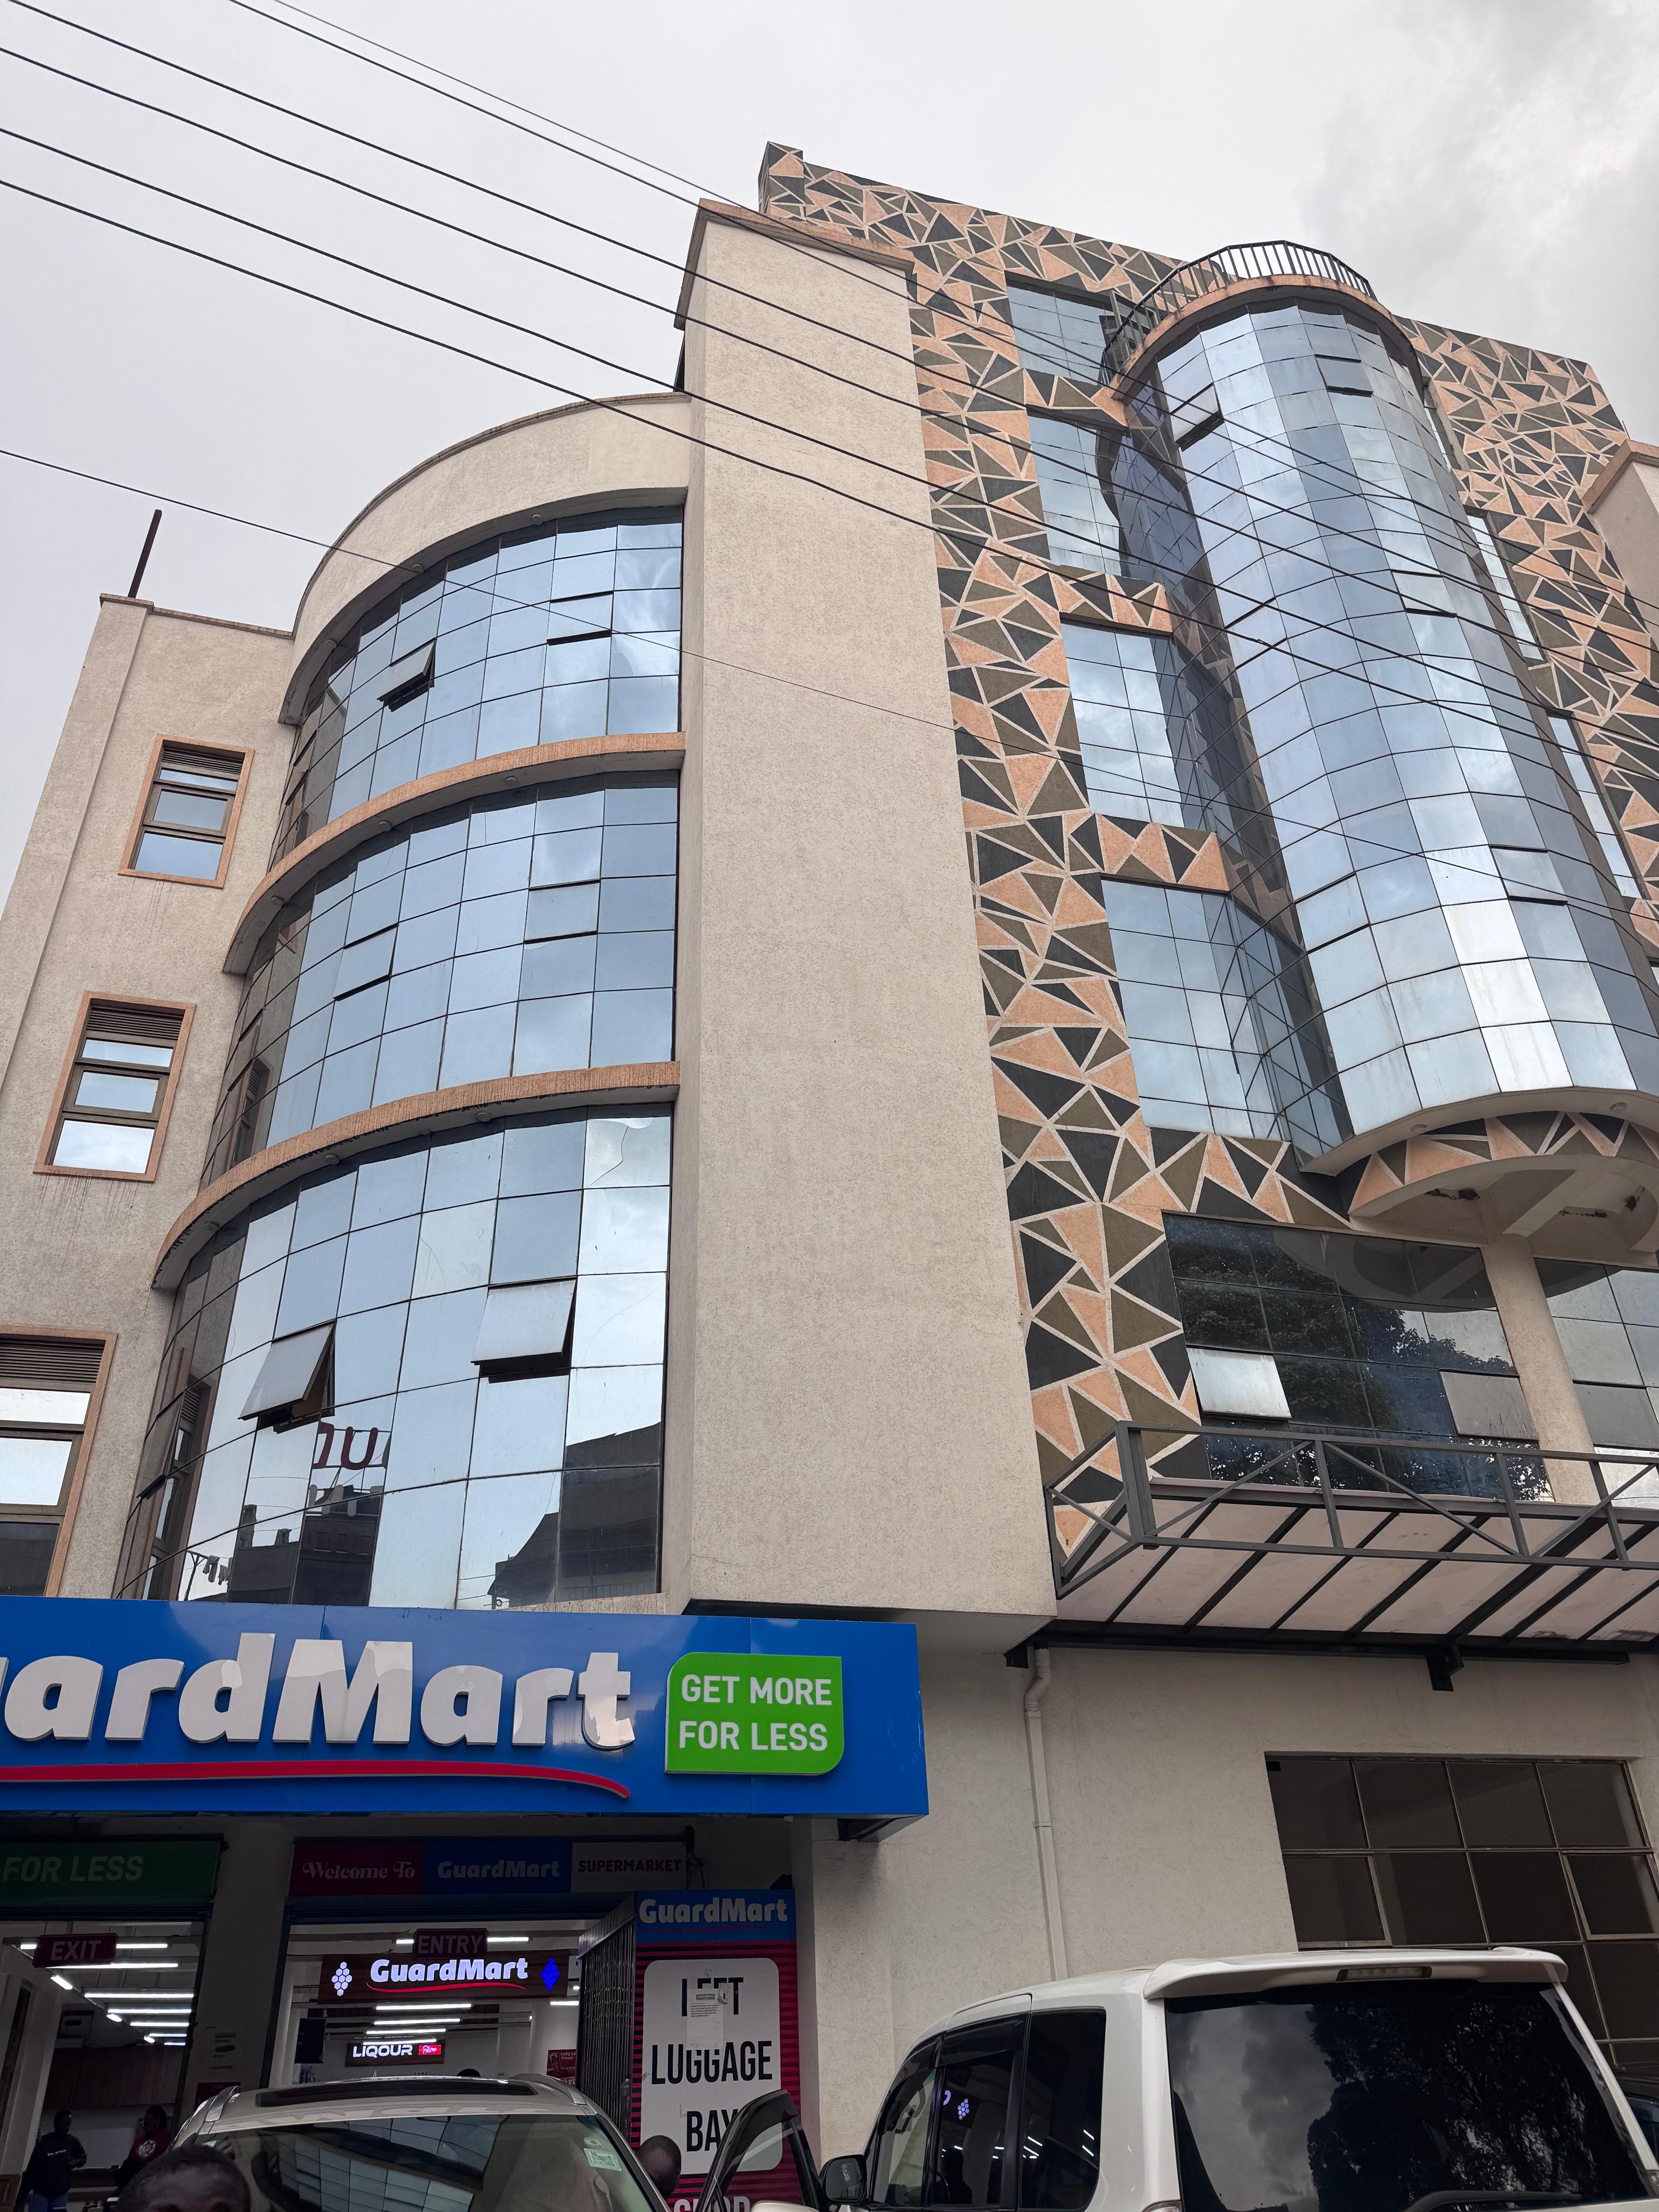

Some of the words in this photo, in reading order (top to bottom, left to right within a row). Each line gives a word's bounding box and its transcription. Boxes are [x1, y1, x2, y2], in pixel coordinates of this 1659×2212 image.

[0, 1632, 635, 1749] ardMart
[682, 1673, 740, 1703] GET
[750, 1677, 832, 1706] MORE
[680, 1720, 740, 1750] FOR
[751, 1722, 827, 1752] LESS
[2, 1856, 62, 1882] FOR
[69, 1855, 144, 1882] LESS
[303, 1861, 388, 1880] Welcome
[393, 1861, 415, 1879] To
[437, 1859, 560, 1879] GuardMart
[577, 1859, 682, 1873] SUPERMARKET
[639, 1897, 788, 1924] GuardMart
[50, 1939, 102, 1961] EXIT
[417, 1934, 483, 1954] ENTRY
[371, 1957, 529, 1983] GuardMart
[681, 1976, 744, 2017] LT
[352, 2044, 413, 2058] LIQOUR
[651, 2040, 773, 2085] LUGGAGE
